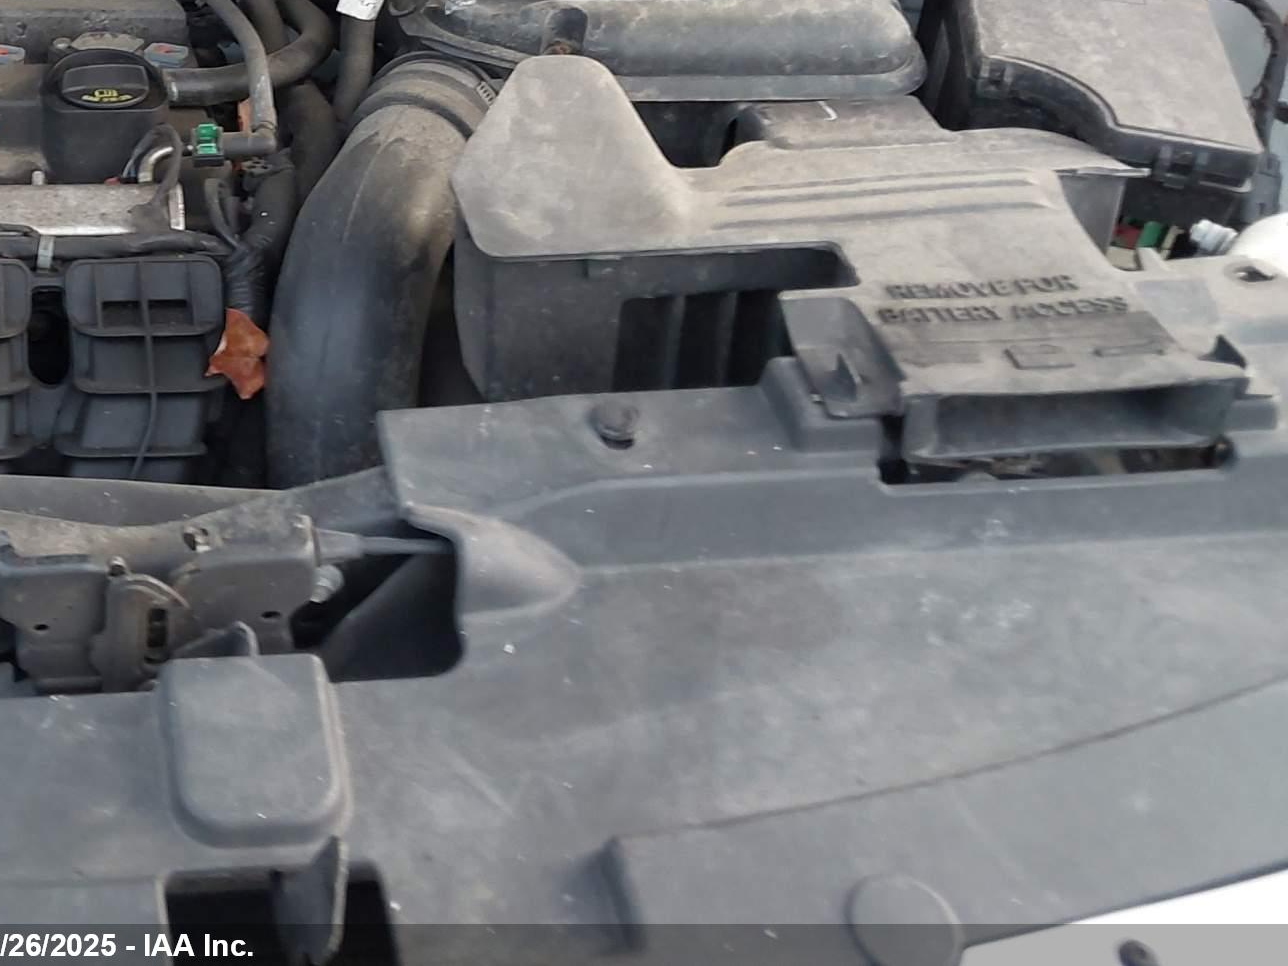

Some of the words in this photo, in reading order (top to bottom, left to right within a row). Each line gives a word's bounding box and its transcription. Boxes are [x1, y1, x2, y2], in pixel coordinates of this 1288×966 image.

[885, 280, 1010, 299] REMOVE
[1015, 274, 1080, 294] FOR
[875, 304, 1002, 324] BATTERY
[1011, 296, 1129, 320] ACCESS
